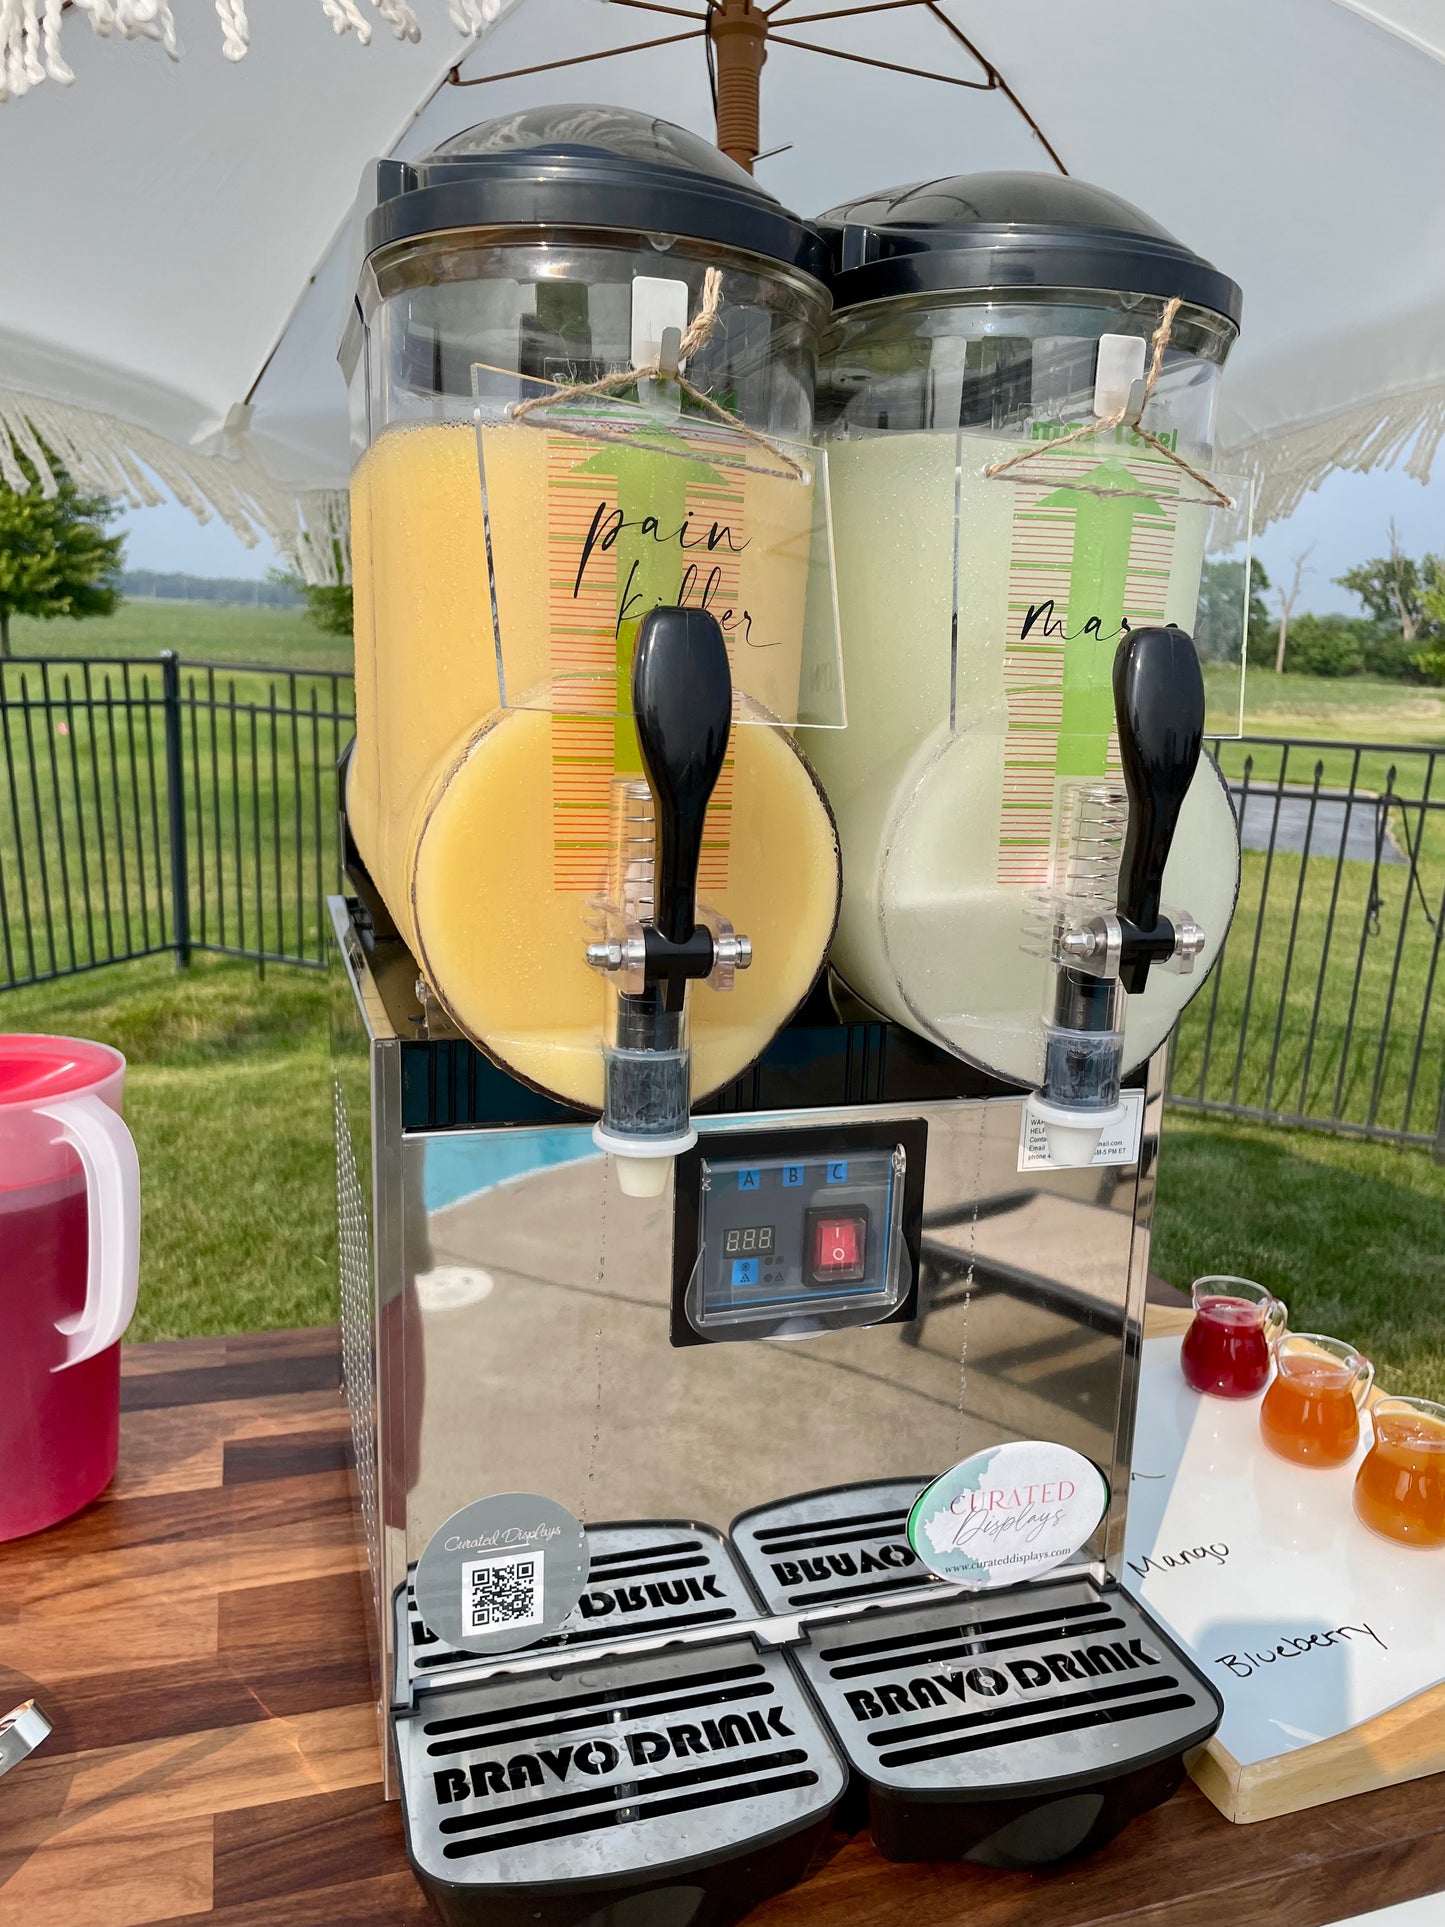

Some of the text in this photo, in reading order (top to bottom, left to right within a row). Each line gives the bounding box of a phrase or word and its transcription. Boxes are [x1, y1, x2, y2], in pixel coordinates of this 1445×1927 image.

[573, 502, 752, 599] pain
[1028, 1144, 1046, 1152] Email
[743, 1163, 843, 1187] A B C
[950, 1480, 1075, 1515] CURATED
[444, 1523, 561, 1551] Curated Displays
[952, 1502, 1067, 1546] Displays
[945, 1547, 1071, 1573] www.curateddisplays.com
[1127, 1542, 1229, 1578] Mango
[1214, 1623, 1388, 1678] Blueberry
[844, 1638, 1160, 1722] BRAVO DRINK
[433, 1705, 795, 1805] BRAVO DRINK
